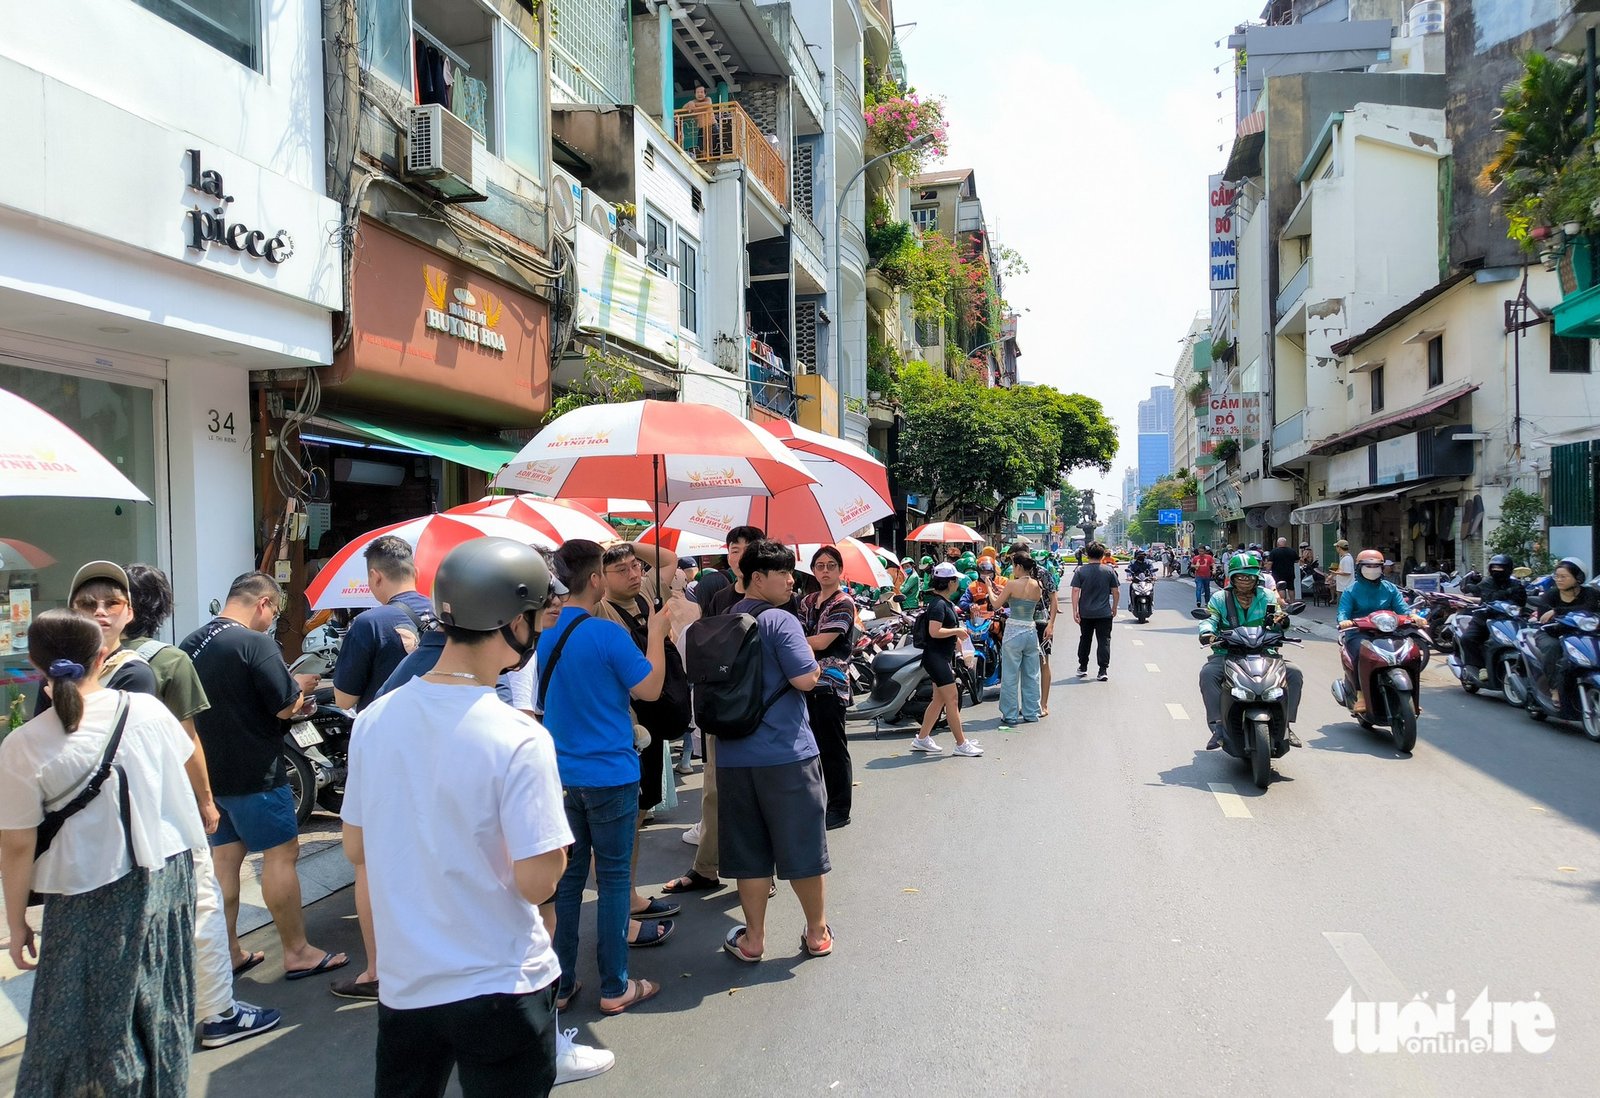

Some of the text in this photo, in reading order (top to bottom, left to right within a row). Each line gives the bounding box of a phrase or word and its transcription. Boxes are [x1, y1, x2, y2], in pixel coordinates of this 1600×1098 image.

[186, 149, 234, 202] la
[186, 206, 286, 264] piece
[1211, 237, 1236, 257] HÙNG
[1211, 260, 1236, 281] PHÁT
[479, 326, 507, 352] HOA
[1211, 394, 1239, 410] CẦM
[208, 409, 235, 435] 34
[1215, 410, 1235, 425] ĐỒ
[1211, 426, 1225, 435] 2.5%
[1230, 426, 1239, 434] 3%
[200, 635, 212, 649] PAST
[192, 648, 201, 659] THE
